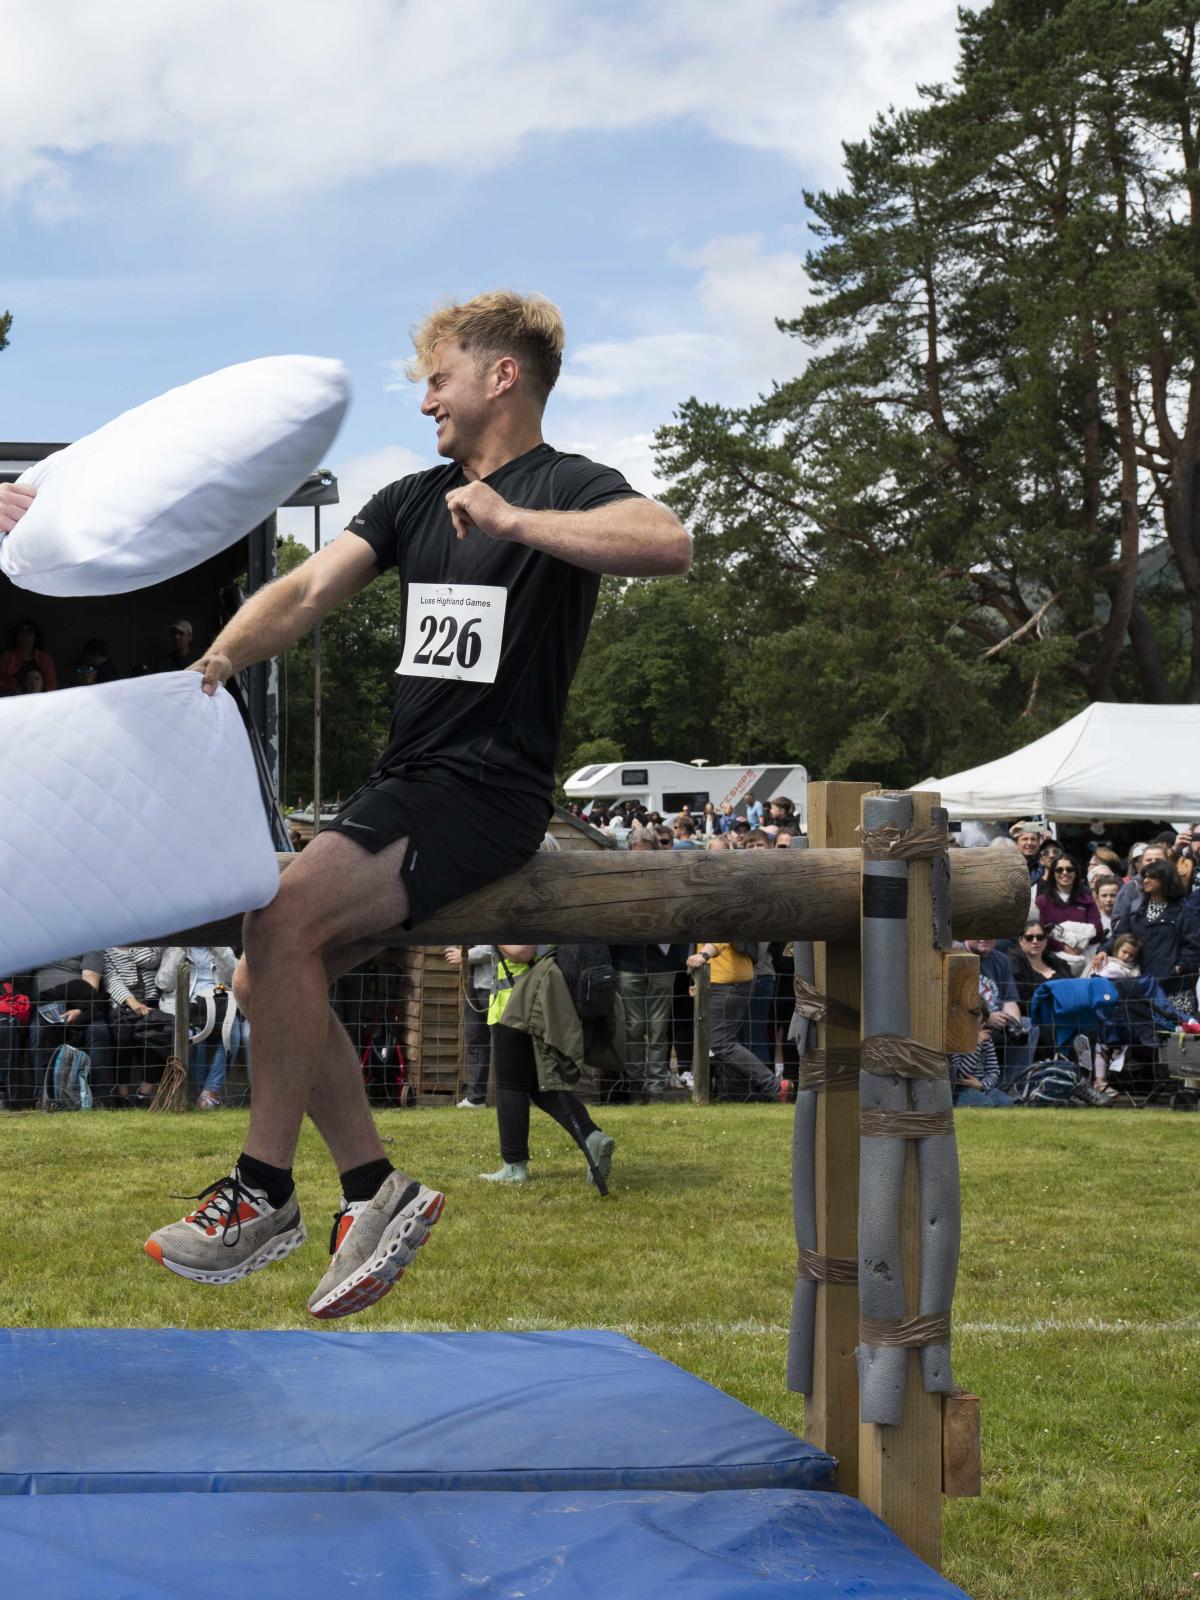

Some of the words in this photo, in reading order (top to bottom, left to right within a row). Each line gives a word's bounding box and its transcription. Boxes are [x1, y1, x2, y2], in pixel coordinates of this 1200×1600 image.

[420, 596, 435, 605] Luss
[437, 597, 464, 607] Highland
[465, 598, 491, 607] Games
[413, 615, 482, 669] 226
